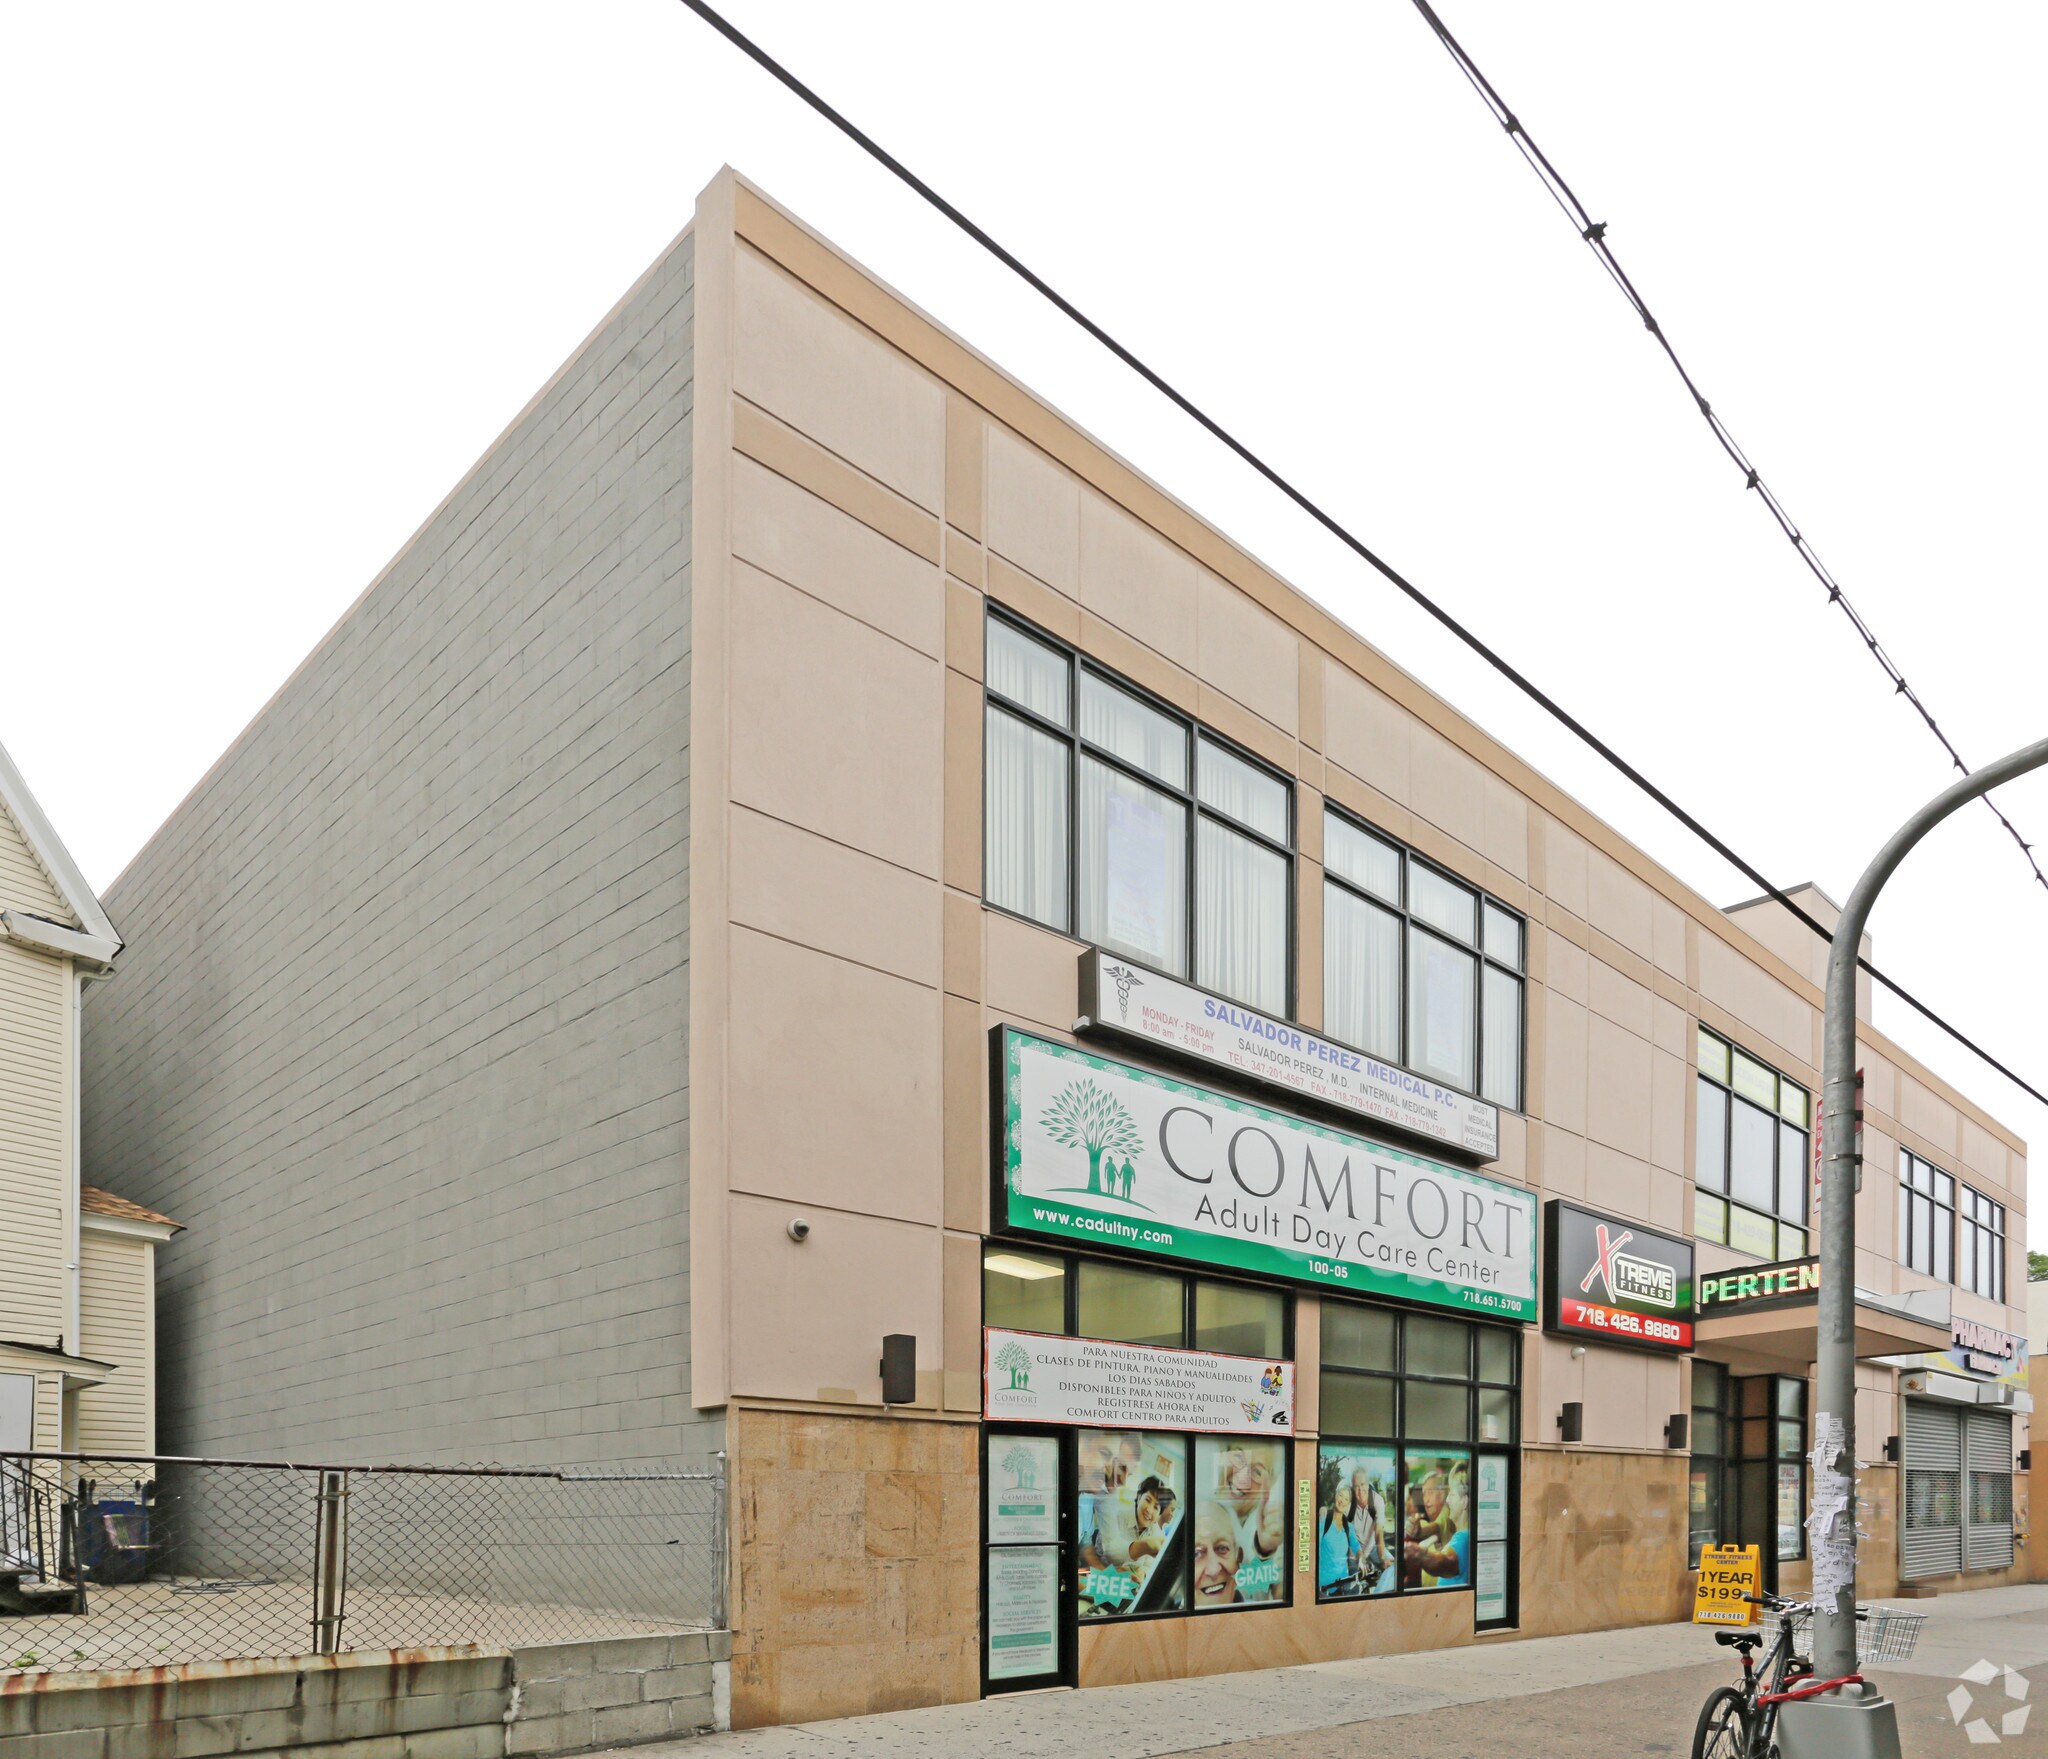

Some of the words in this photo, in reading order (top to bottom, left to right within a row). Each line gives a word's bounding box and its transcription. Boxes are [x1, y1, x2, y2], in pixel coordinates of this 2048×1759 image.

[1141, 1006, 1179, 1028] MONDAY
[1185, 1022, 1215, 1041] FRIDAY
[1142, 1019, 1160, 1034] 8:00
[1162, 1029, 1175, 1040] am
[1183, 1034, 1201, 1049] 5:00
[1202, 1042, 1214, 1054] pm
[1203, 999, 1302, 1051] SALVADOR
[1307, 1040, 1361, 1073] PEREZ
[1366, 1061, 1430, 1100] MEDICAL
[1434, 1088, 1458, 1110] P.C.
[1238, 1037, 1291, 1067] SALVADOR
[1331, 1072, 1350, 1089] M.D.
[1359, 1082, 1400, 1107] INTERNAL
[1401, 1098, 1439, 1121] MEDICINE
[1250, 1059, 1304, 1088] 347-201-4567
[1311, 1081, 1327, 1096] FAX
[1334, 1089, 1382, 1114] 718-779-1470
[1384, 1109, 1400, 1122] FAX
[1472, 1103, 1488, 1116] MOST
[1464, 1125, 1496, 1142] INSURANCE
[1467, 1114, 1492, 1130] MEDICAL
[1464, 1137, 1495, 1153] ACCEPTED
[1158, 1105, 1524, 1260] COMFORT
[1032, 1207, 1173, 1246] www.cadultny.com
[1194, 1192, 1280, 1238] Adult
[1292, 1213, 1346, 1259] Day
[1357, 1230, 1418, 1269] Care
[1426, 1247, 1500, 1285] Center
[1308, 1259, 1349, 1279] 100-05
[1462, 1290, 1522, 1313] 718.651.5700
[1620, 1281, 1672, 1300] FITNESS
[1951, 1317, 2018, 1361] PHARMACY
[1036, 1354, 1074, 1366] CLASES
[1077, 1359, 1091, 1368] DE
[1144, 1365, 1174, 1376] PIANO
[1176, 1369, 1182, 1377] Y
[1184, 1370, 1253, 1384] MANUALIDADES
[1083, 1346, 1108, 1357] PARA
[1110, 1349, 1154, 1362] NUESTRA
[1157, 1354, 1218, 1369] COMUNIDAD
[1059, 1381, 1126, 1396] DISPONIBLES
[1129, 1387, 1152, 1397] PARA
[1188, 1392, 1195, 1400] Y
[1195, 1392, 1236, 1404] ADULTOS
[1108, 1373, 1126, 1383] LOS
[1129, 1376, 1151, 1386] DIAS
[1154, 1378, 1196, 1390] SABADOS
[994, 1392, 1038, 1404] COMFORT
[1097, 1397, 1155, 1409] REGISTRESE
[1156, 1401, 1190, 1412] AHORA
[1192, 1404, 1205, 1413] EN
[1067, 1407, 1119, 1420] COMFORT
[1121, 1411, 1162, 1421] CENTRO
[1165, 1413, 1187, 1424] PARA
[1189, 1415, 1230, 1425] ADULTOS
[1085, 1573, 1131, 1598] FREE
[1234, 1563, 1280, 1587] GRATIS
[1698, 1586, 1742, 1599] $199
